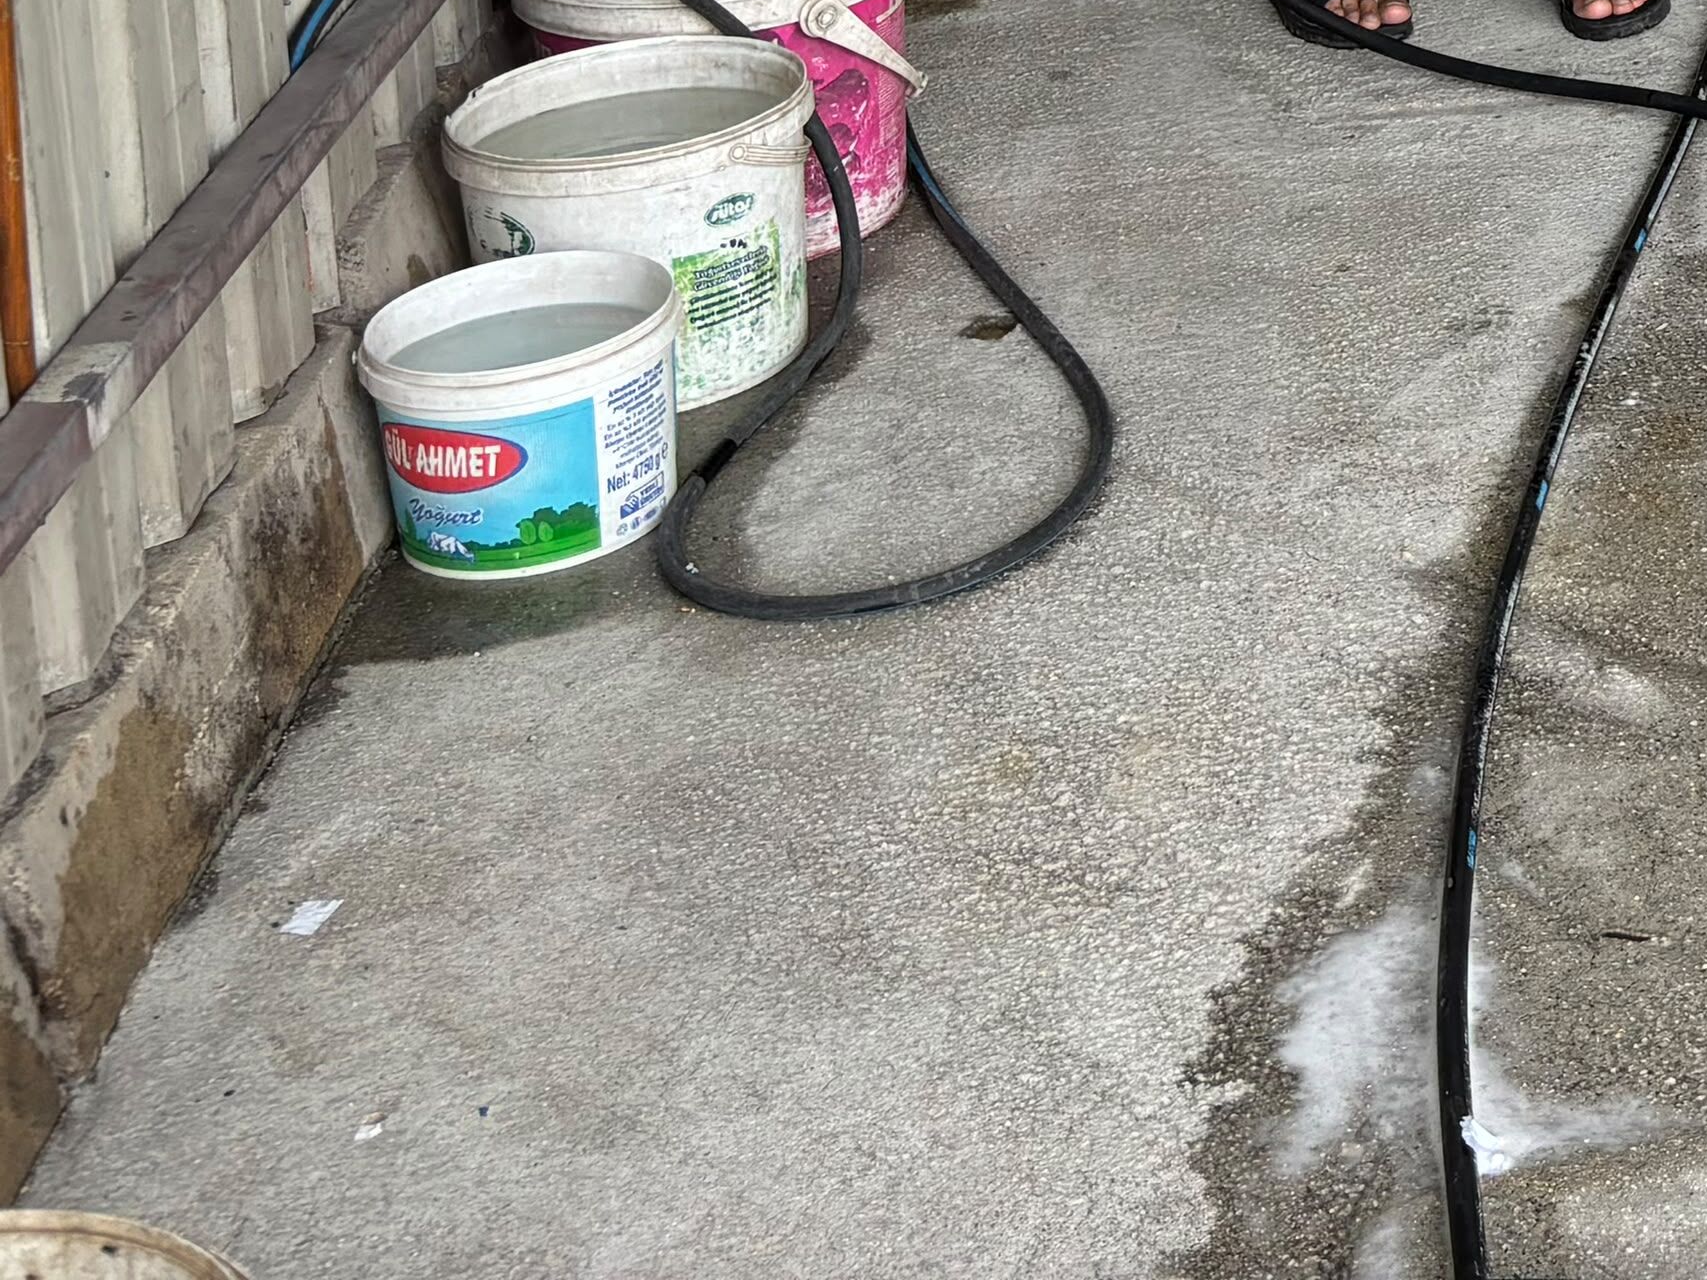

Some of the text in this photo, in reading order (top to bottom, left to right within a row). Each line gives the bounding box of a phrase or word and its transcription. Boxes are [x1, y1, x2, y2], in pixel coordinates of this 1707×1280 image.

[416, 444, 502, 478] AHMET
[605, 472, 631, 494] Net:
[408, 497, 485, 526] Yoğurt
